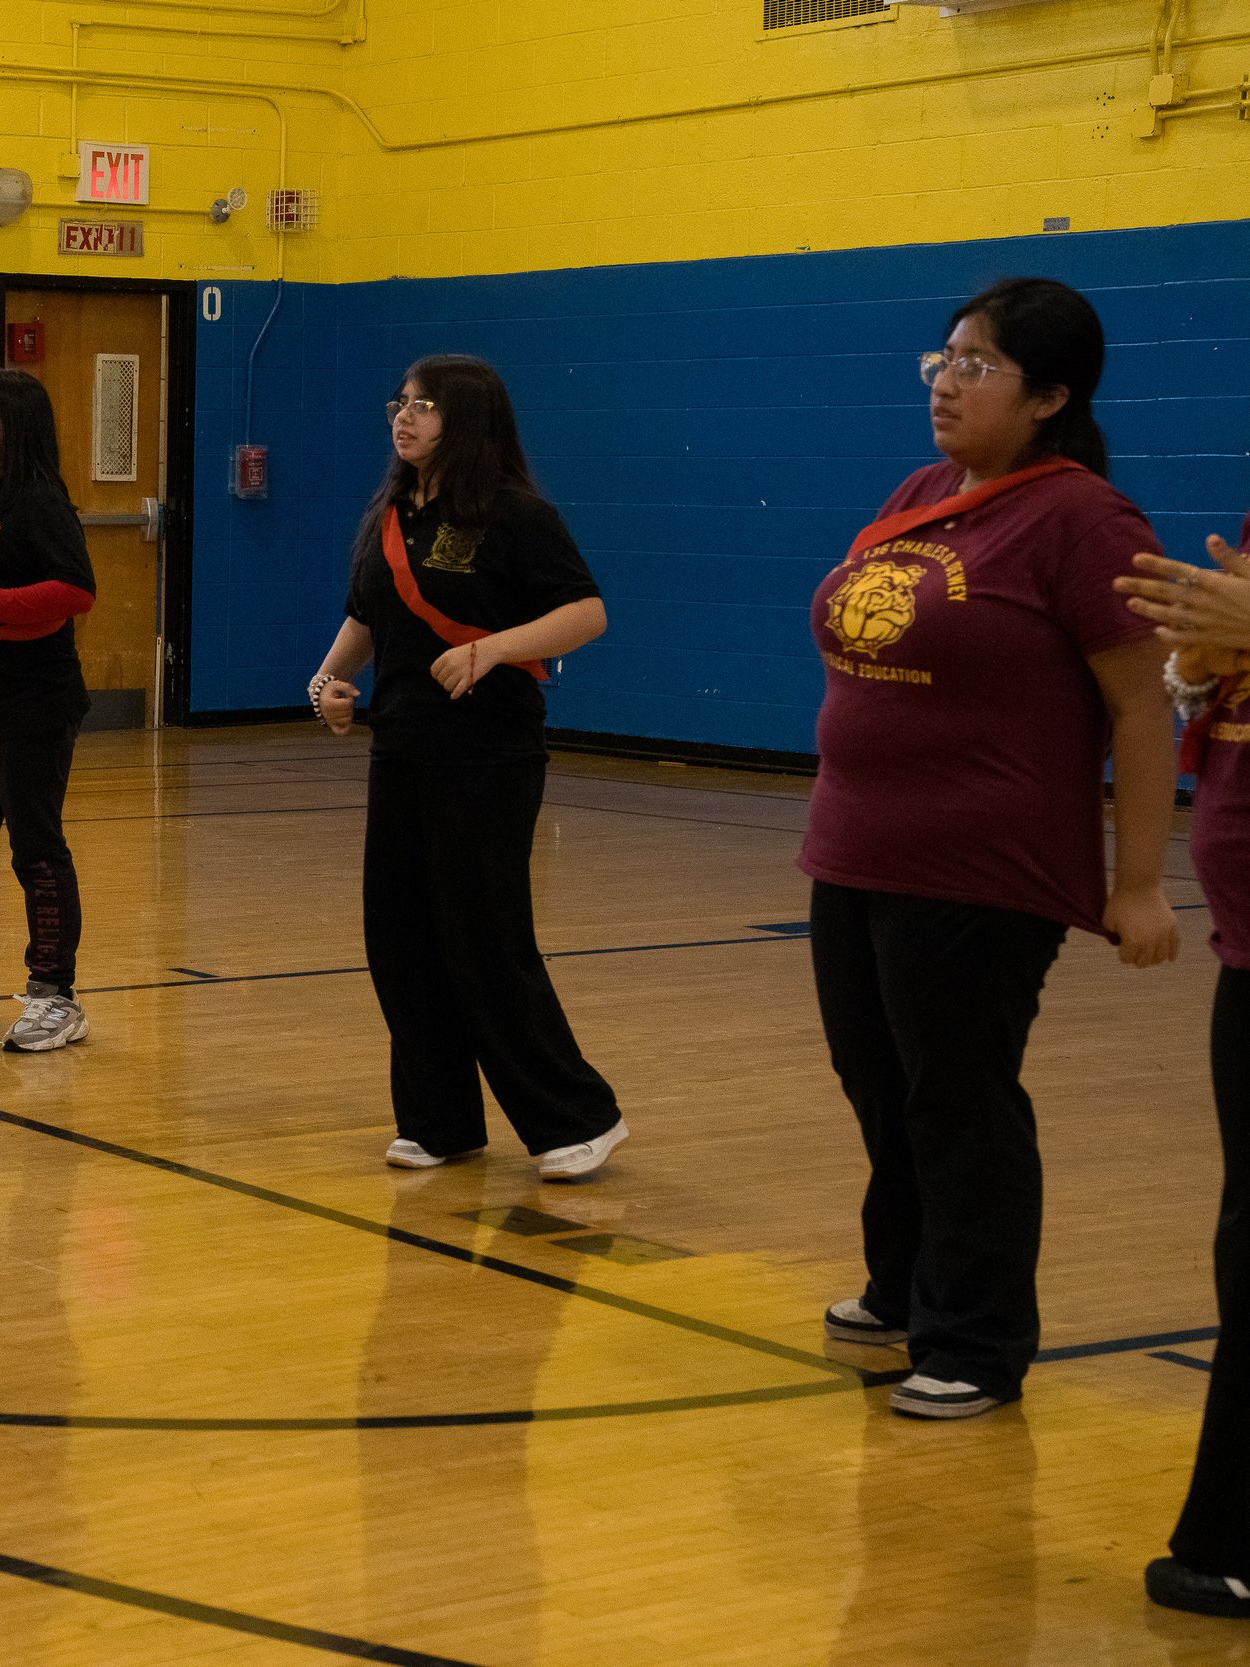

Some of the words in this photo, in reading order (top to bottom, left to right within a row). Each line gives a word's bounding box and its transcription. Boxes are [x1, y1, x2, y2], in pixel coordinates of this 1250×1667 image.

[91, 150, 144, 200] EXIT
[892, 540, 950, 561] CHARLES
[858, 663, 932, 685] EDUCATION
